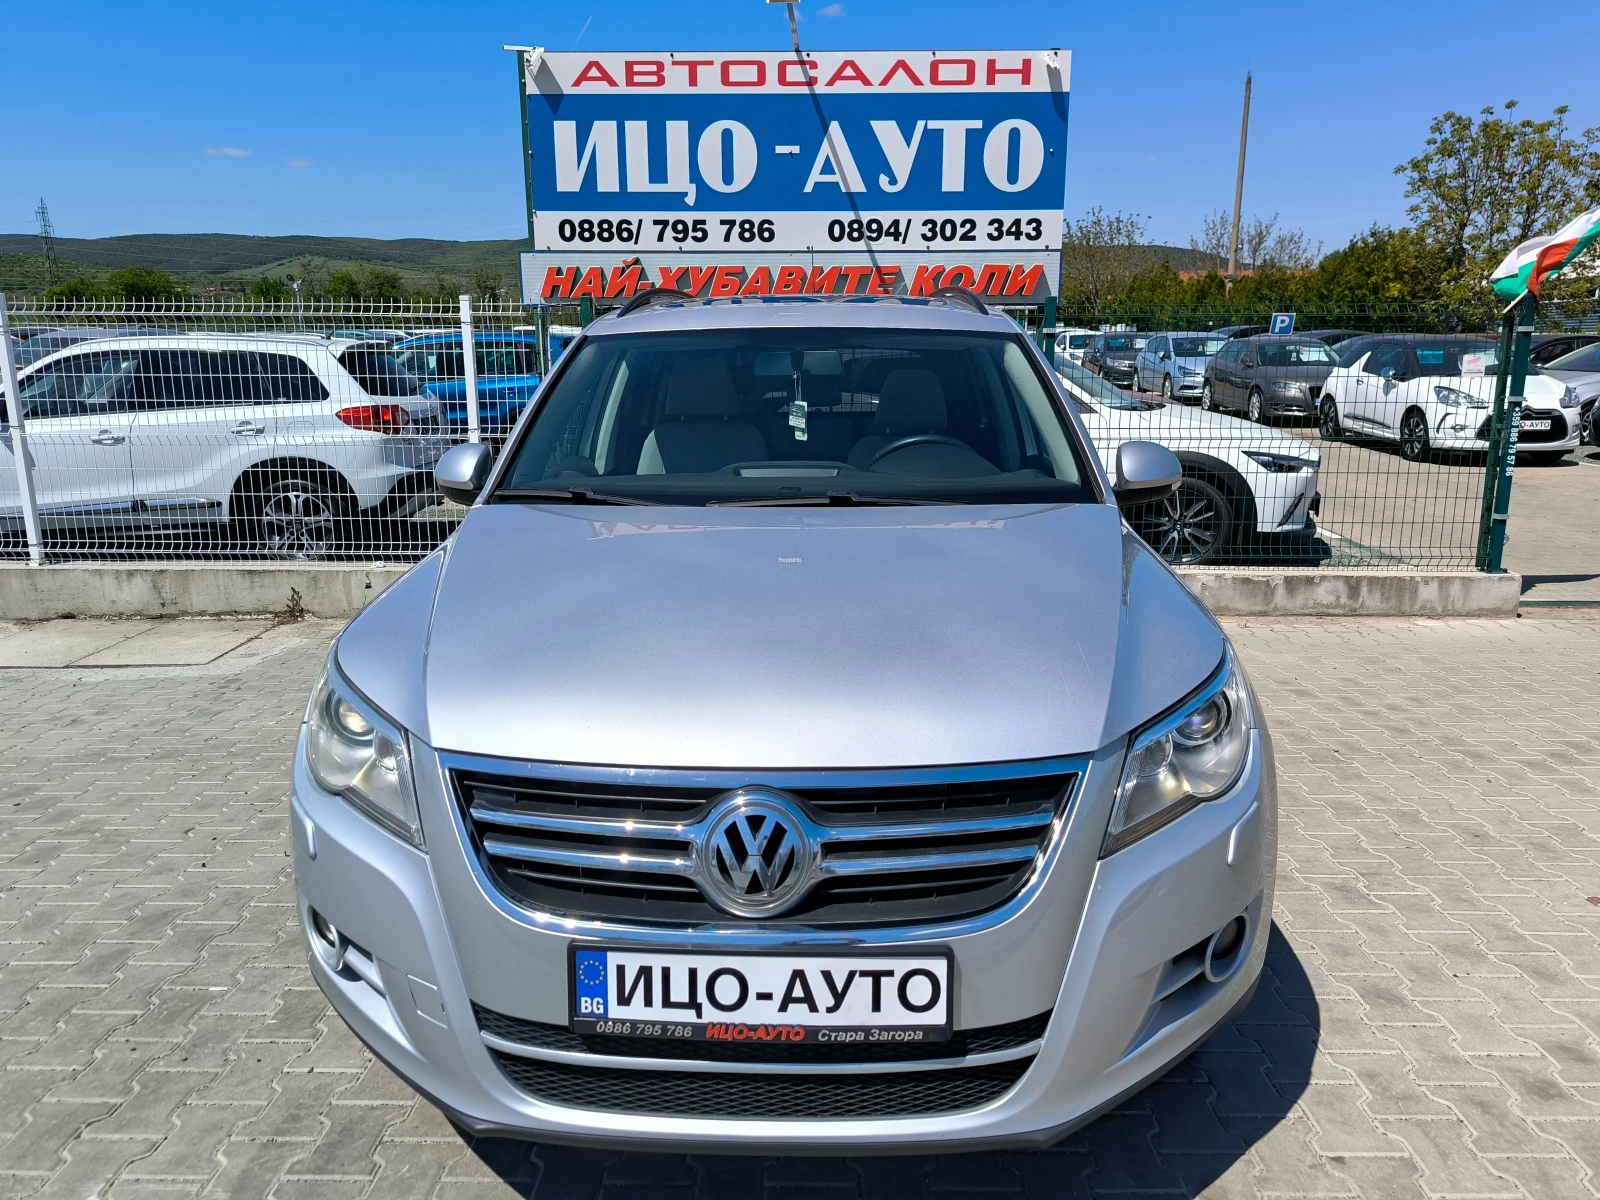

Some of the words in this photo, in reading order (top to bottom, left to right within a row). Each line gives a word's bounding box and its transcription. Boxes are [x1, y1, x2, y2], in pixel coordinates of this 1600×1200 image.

[571, 58, 1032, 88] АВТОСАЛОН
[558, 218, 642, 245] 0886/
[652, 219, 709, 243] 795
[719, 218, 776, 243] 786
[827, 218, 912, 245] 0894/
[920, 218, 977, 243] 302
[986, 217, 1043, 242] 343
[908, 263, 1045, 298] КОЛИ
[1274, 315, 1290, 333] P
[1512, 407, 1520, 426] +359
[1520, 421, 1550, 429] О-АУТО
[1510, 428, 1519, 442] 886
[1508, 444, 1517, 454] 79
[1507, 455, 1516, 465] 57
[615, 963, 942, 1019] ИЦО-АУТО
[580, 996, 604, 1014] BG
[596, 1021, 631, 1035] 0886
[636, 1023, 662, 1036] 795
[666, 1025, 693, 1038] 786
[705, 1023, 806, 1041] ИЦО-АУТО
[817, 1029, 865, 1043] Стара
[869, 1028, 923, 1042] Загора
